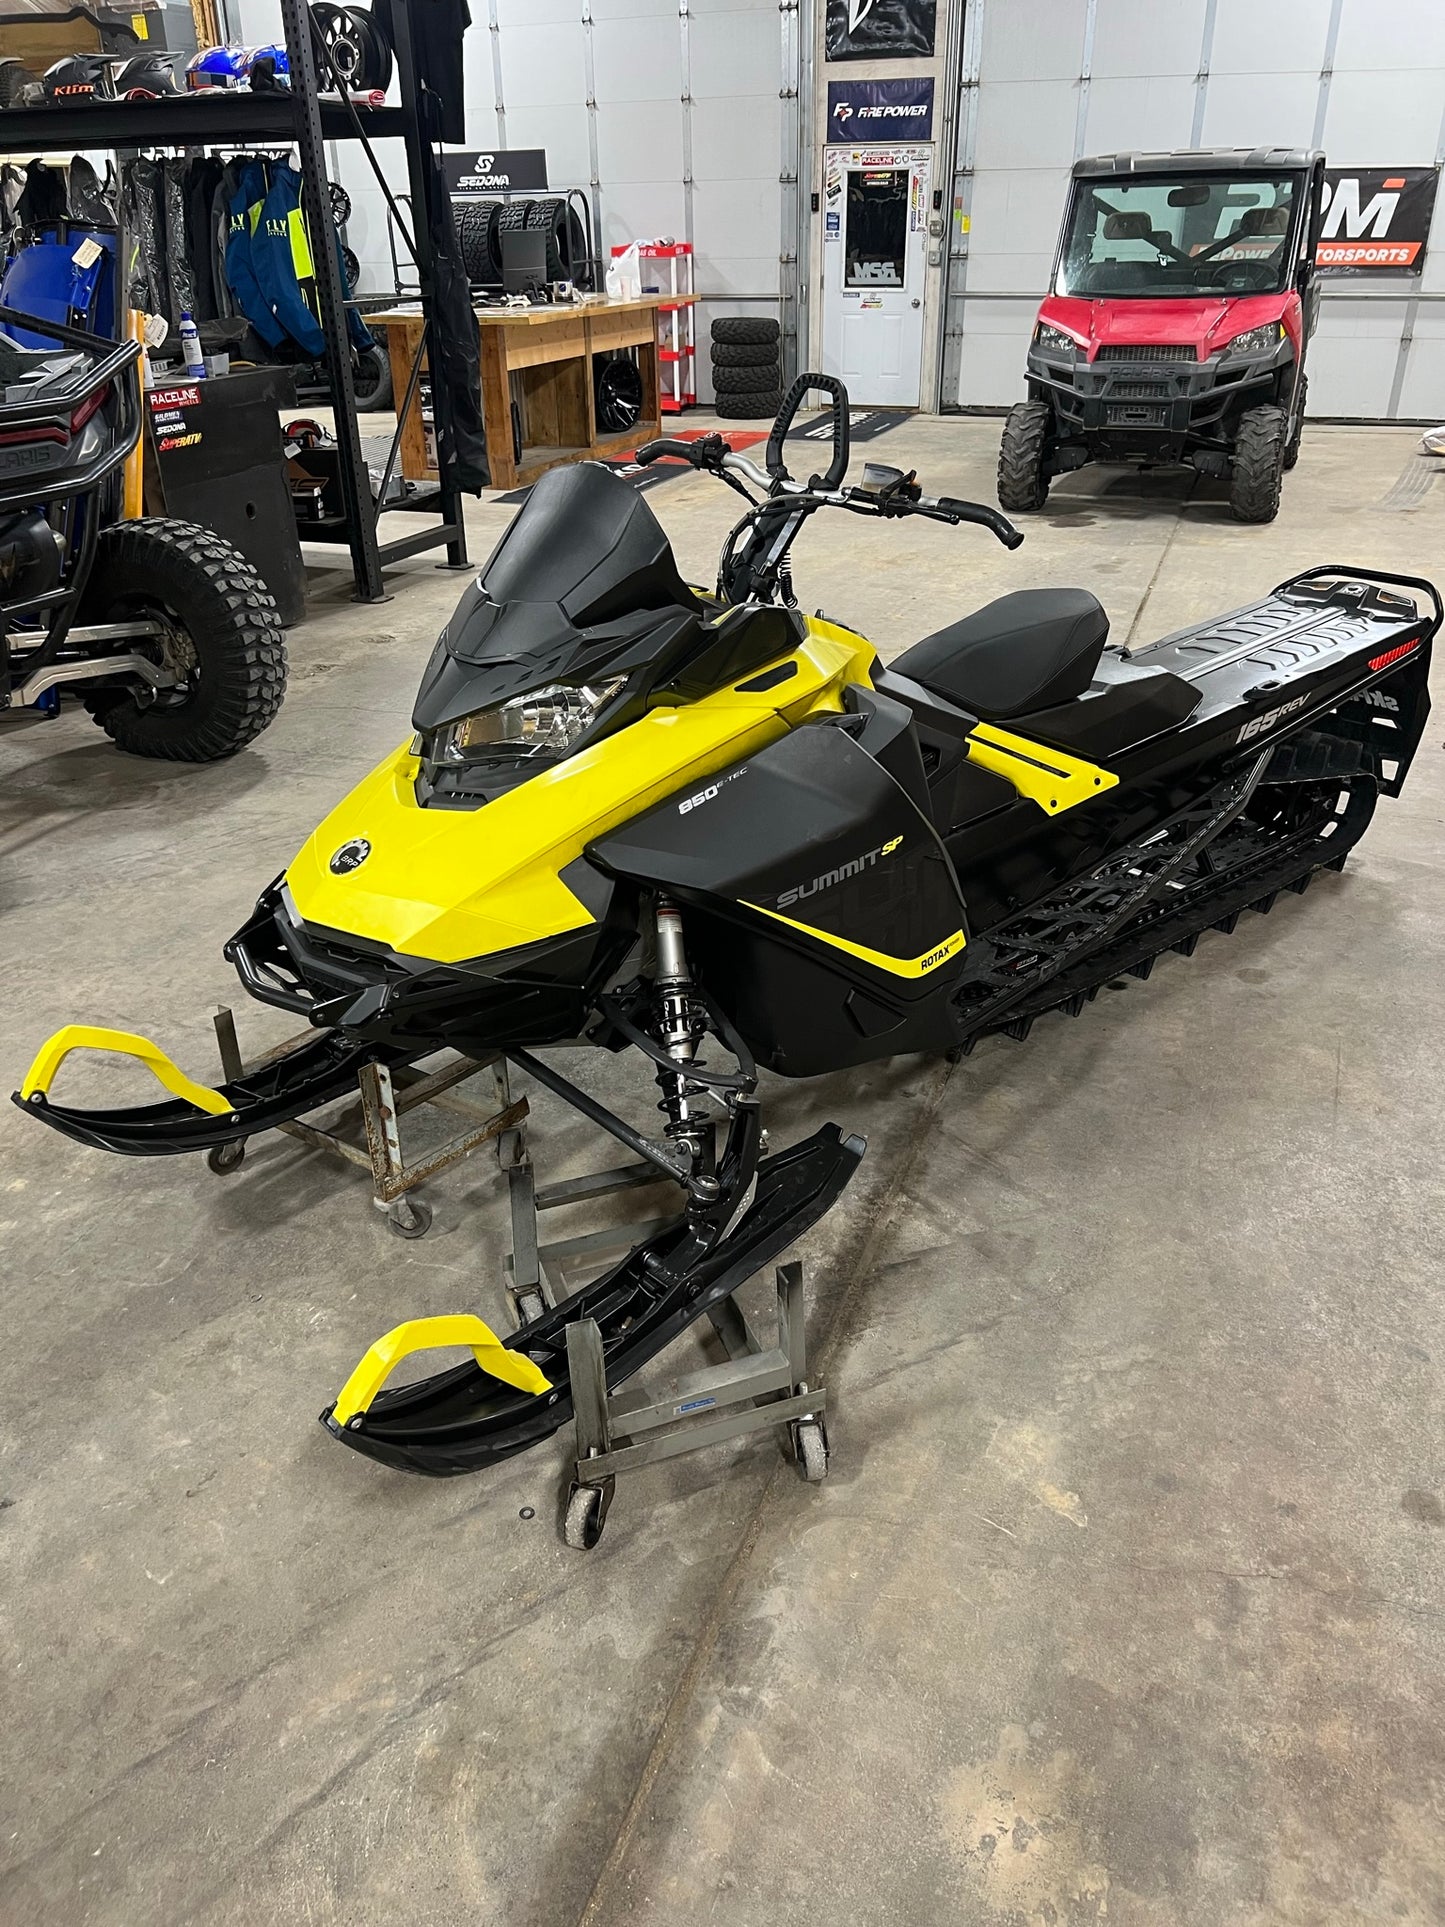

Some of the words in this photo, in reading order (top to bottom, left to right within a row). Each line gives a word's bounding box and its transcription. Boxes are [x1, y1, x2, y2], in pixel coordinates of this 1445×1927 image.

[457, 175, 510, 187] SEDONA
[231, 213, 244, 227] LY
[265, 218, 287, 233] FLY
[150, 388, 198, 405] RACELINE
[156, 422, 187, 435] SEDONA
[340, 855, 359, 867] BRP
[776, 847, 882, 910] SUMMIT
[881, 834, 904, 856] SP
[921, 944, 950, 971] ROTAX
